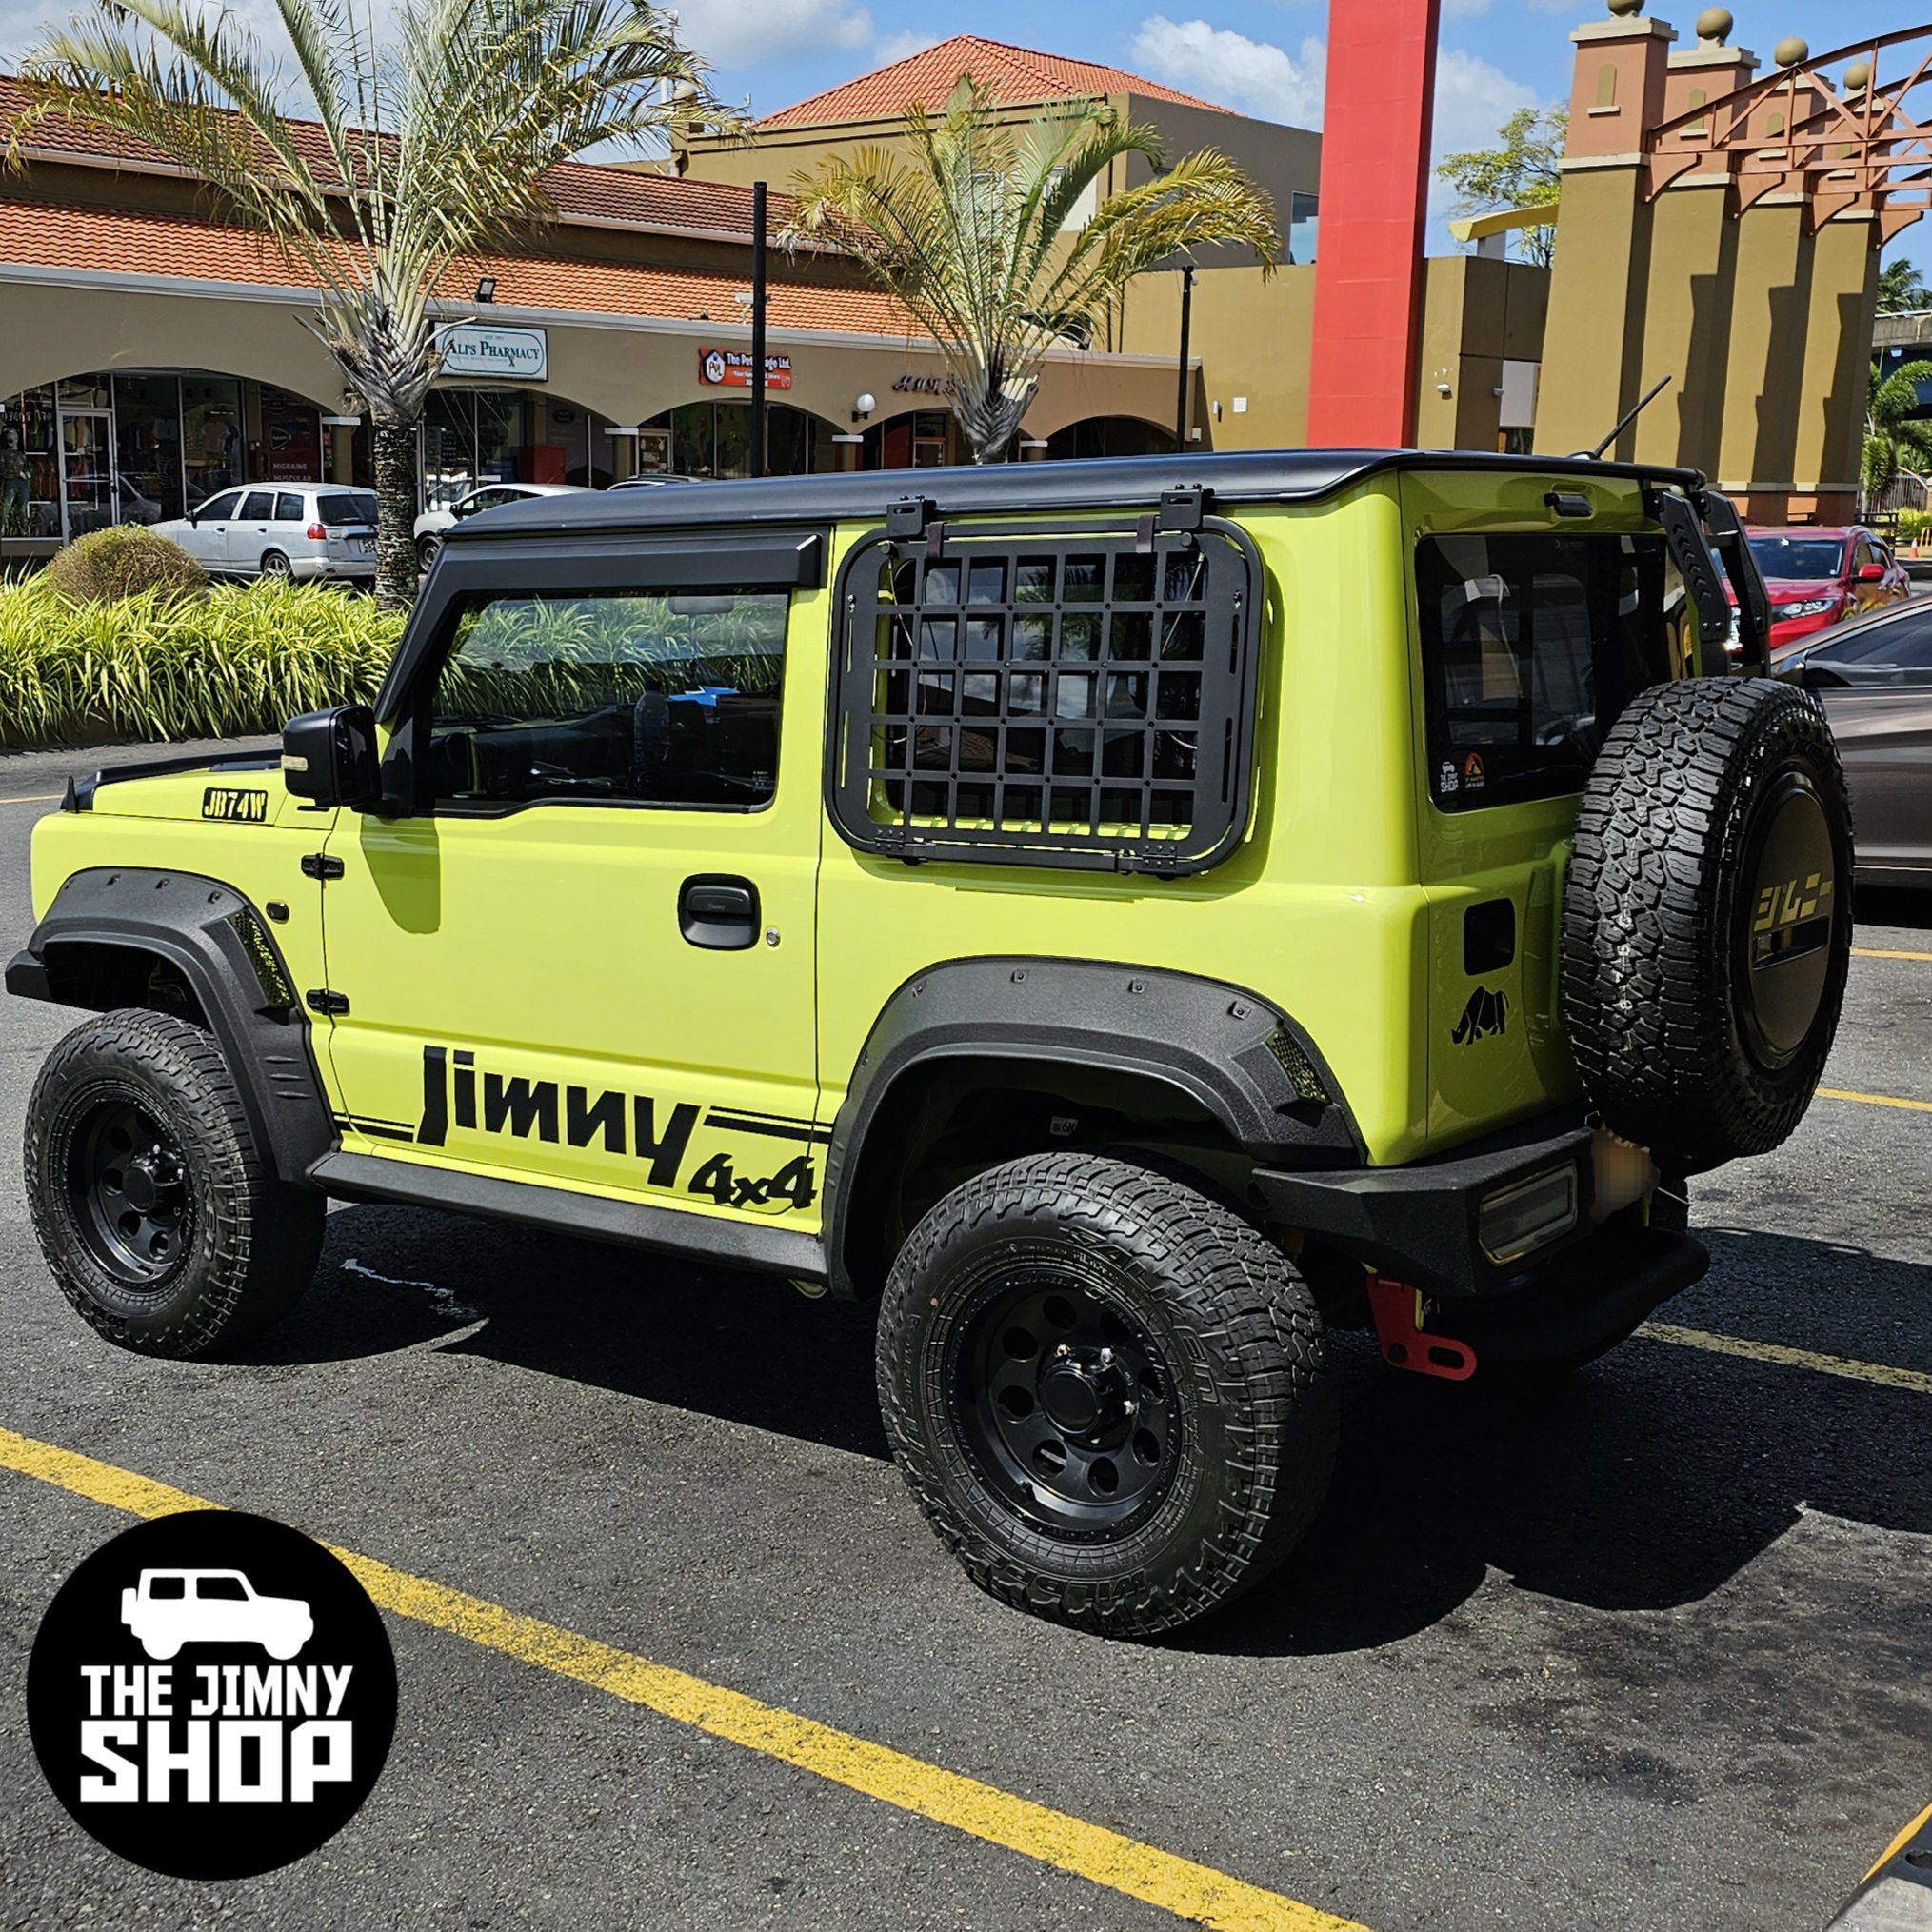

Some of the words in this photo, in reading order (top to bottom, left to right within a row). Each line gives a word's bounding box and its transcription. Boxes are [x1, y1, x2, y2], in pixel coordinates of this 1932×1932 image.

[479, 340, 540, 367] PHARMACY
[204, 790, 266, 819] JB74W
[688, 1153, 818, 1209] 4x4
